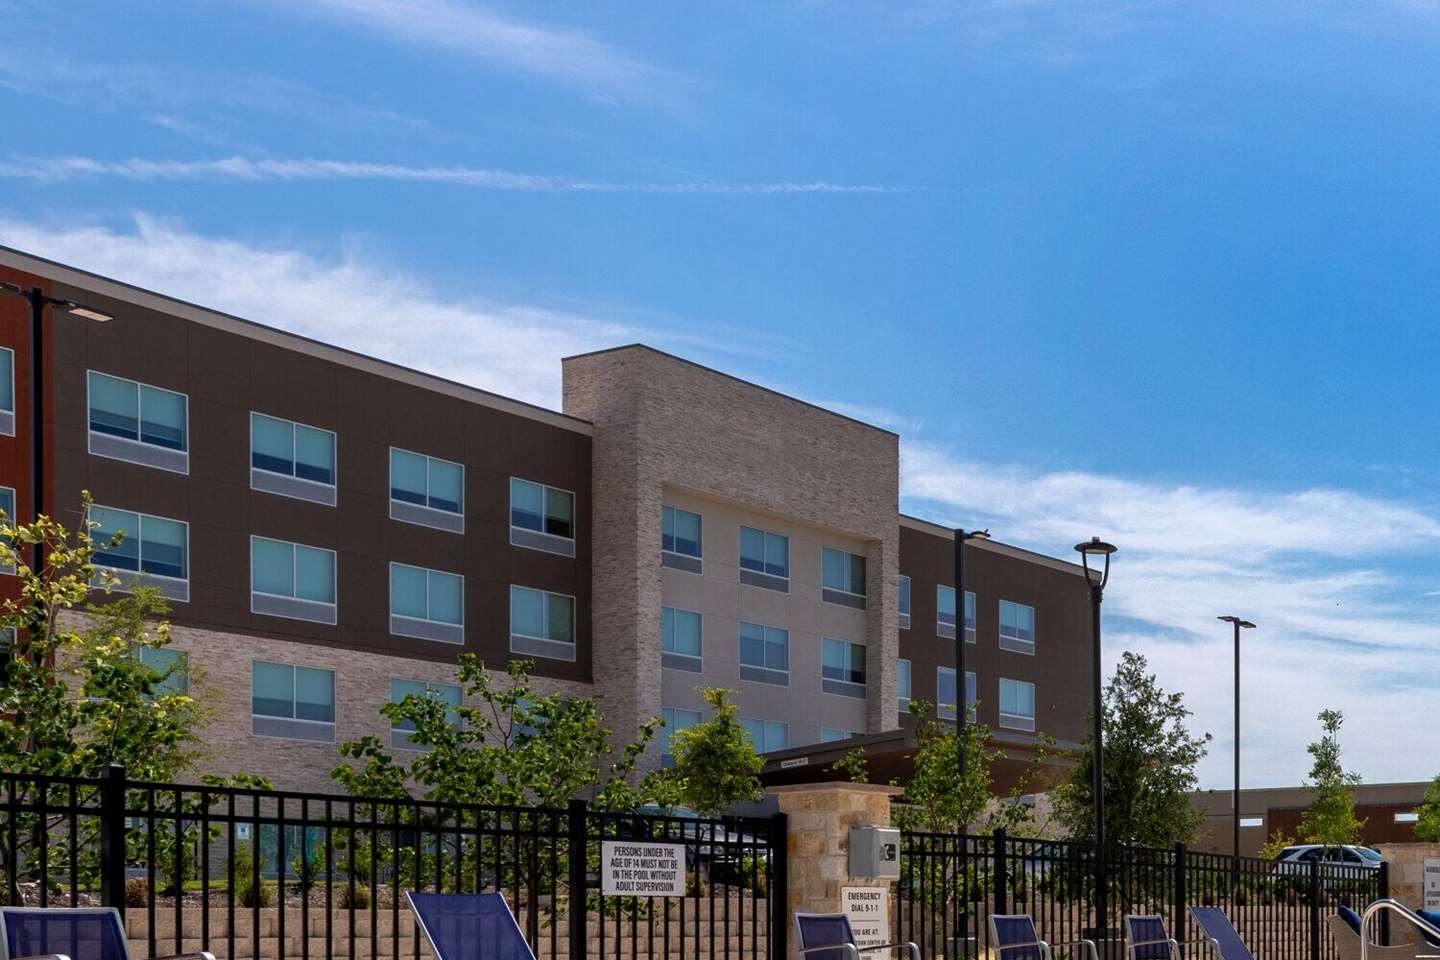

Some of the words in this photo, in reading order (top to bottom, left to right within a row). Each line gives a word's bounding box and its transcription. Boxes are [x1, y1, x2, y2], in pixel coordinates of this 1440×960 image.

[614, 846, 642, 857] PERSONS
[643, 847, 663, 857] UNDER
[664, 848, 675, 858] THE
[610, 858, 623, 868] AGE
[624, 858, 632, 868] OF
[633, 858, 639, 868] 14
[641, 859, 657, 868] MUST
[658, 859, 669, 869] NOT
[671, 860, 678, 869] BE
[612, 869, 620, 880] IN
[621, 870, 632, 880] THE
[634, 870, 649, 880] POOL
[650, 870, 677, 880] WITHOUT
[615, 881, 635, 891] ADULT
[636, 881, 674, 891] SUPERVISION
[848, 892, 881, 900] EMERGENCY
[851, 904, 864, 912] DIAL
[861, 928, 871, 936] ARE
